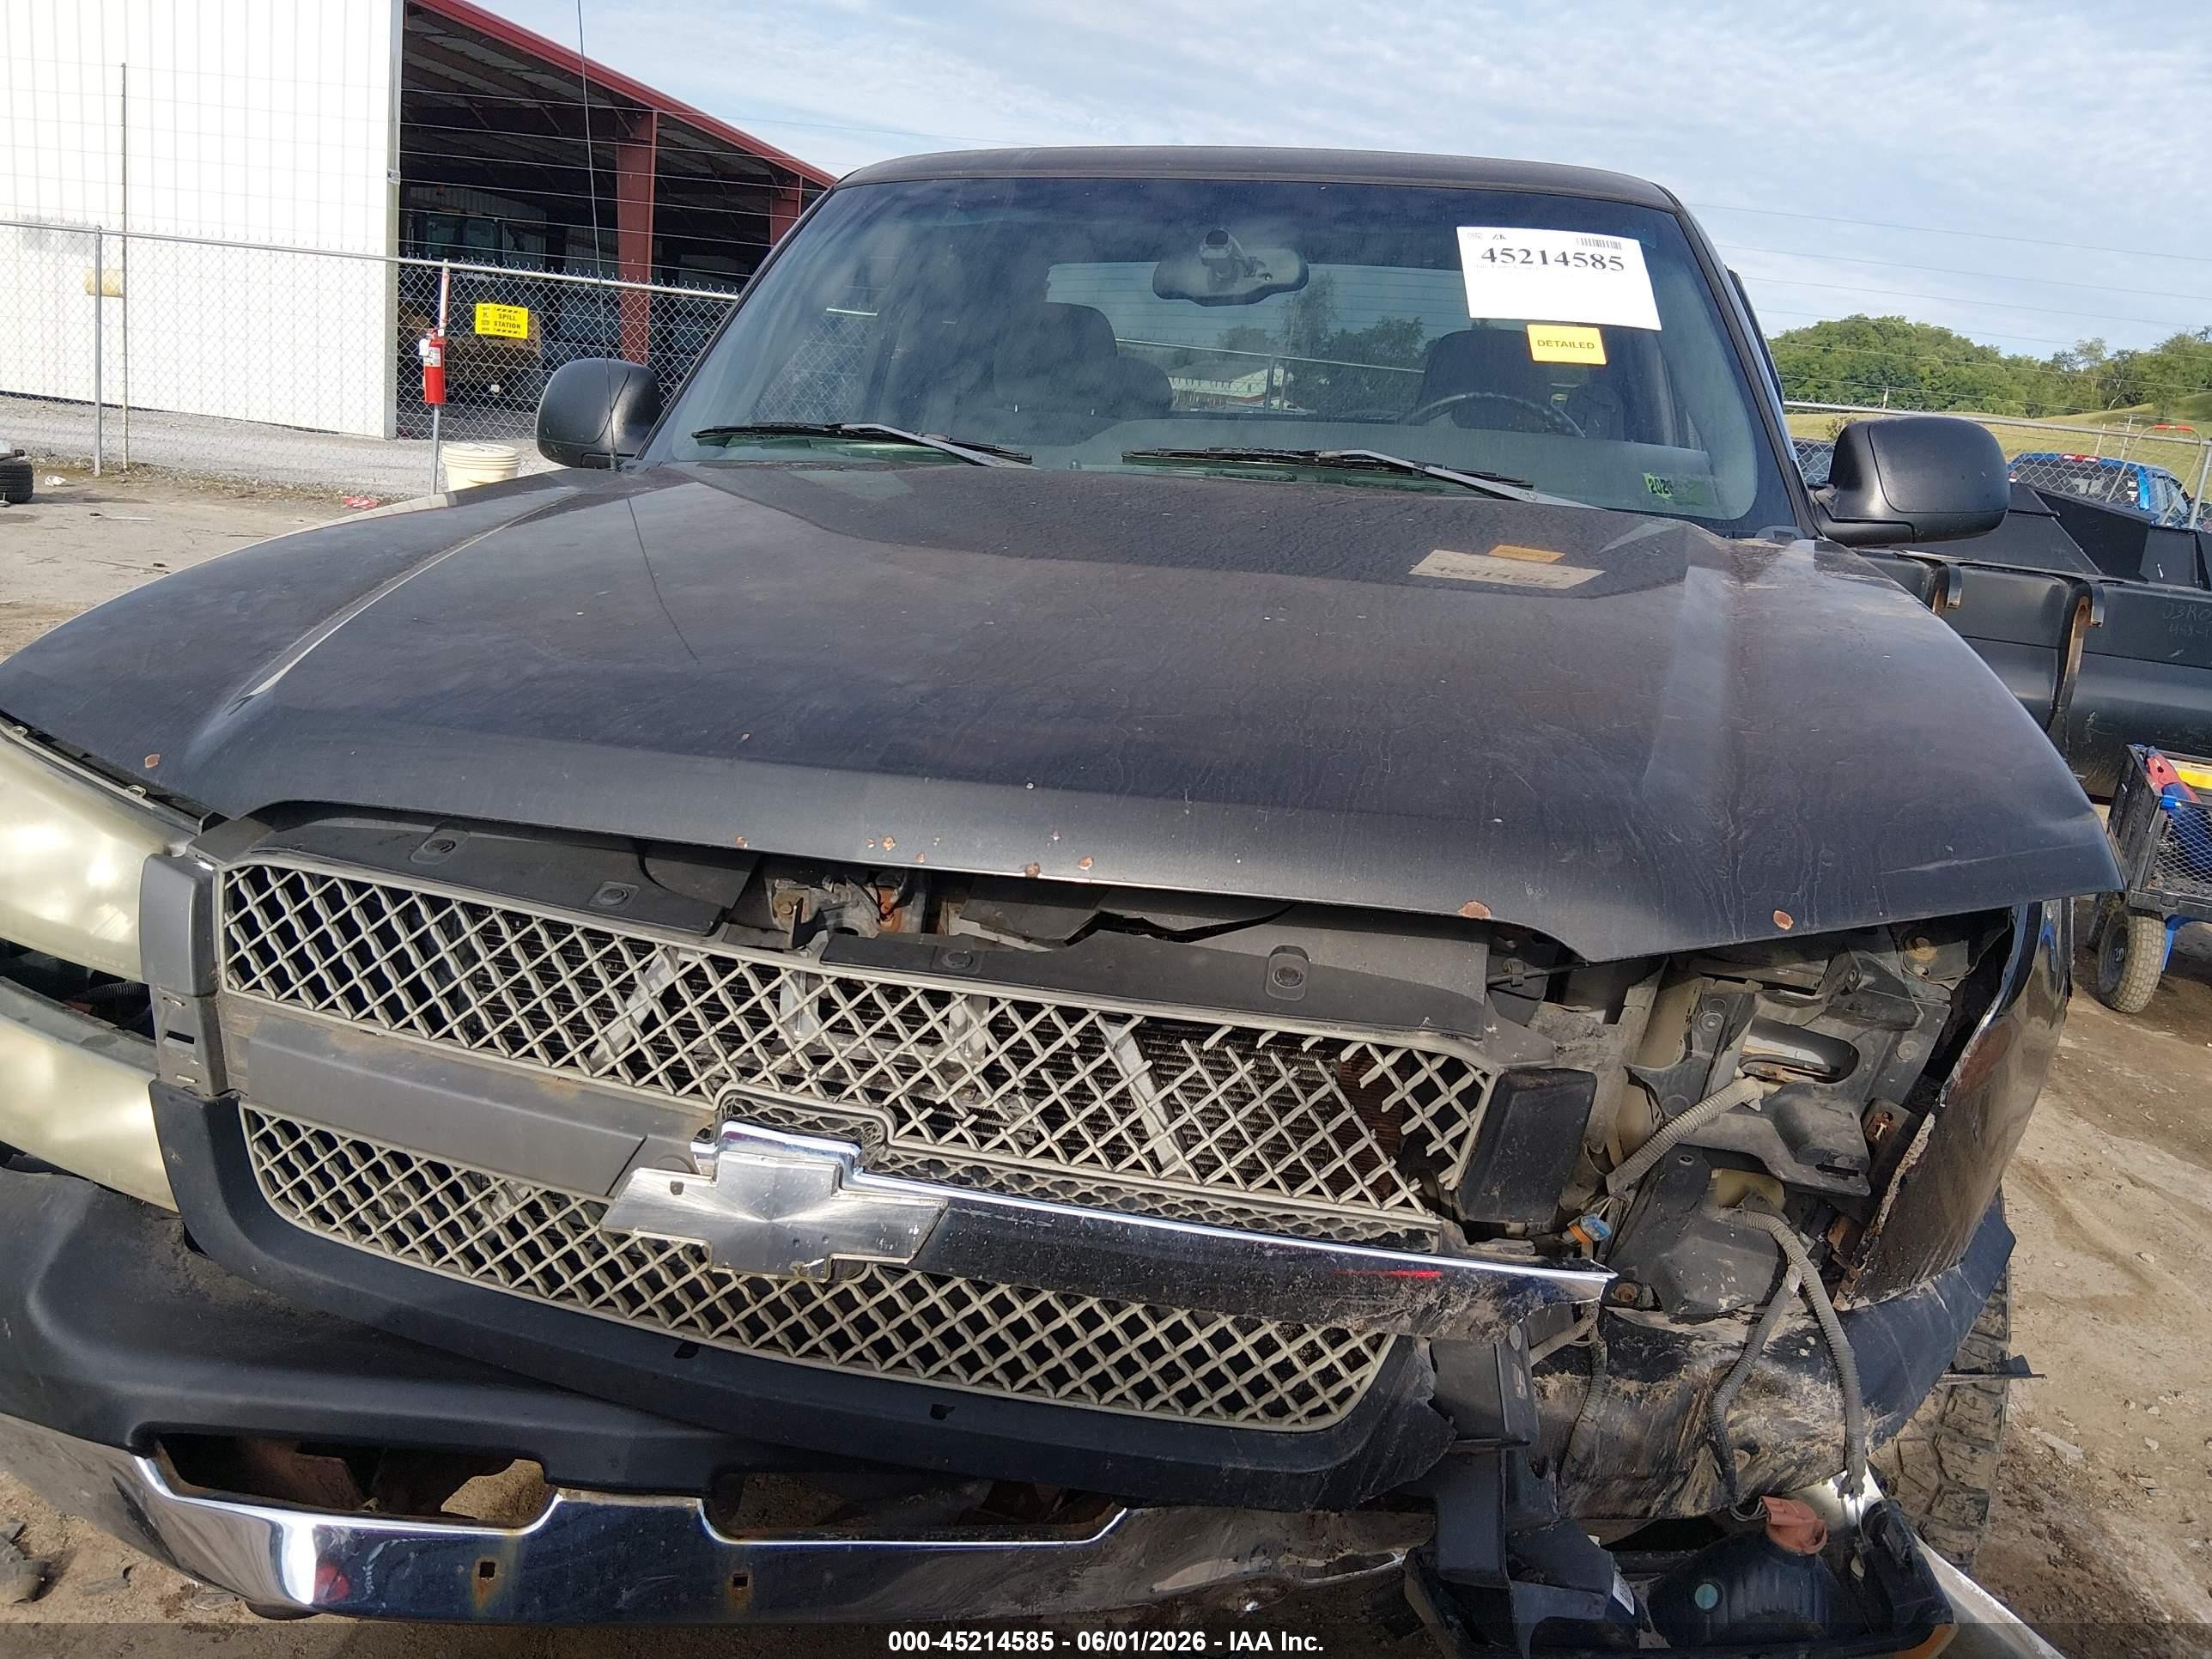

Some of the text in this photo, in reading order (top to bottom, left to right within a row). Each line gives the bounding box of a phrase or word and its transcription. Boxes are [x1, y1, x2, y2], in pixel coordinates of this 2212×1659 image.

[1480, 247, 1625, 271] 45214585
[494, 320, 521, 329] STATION
[1537, 339, 1595, 349] DETAILED
